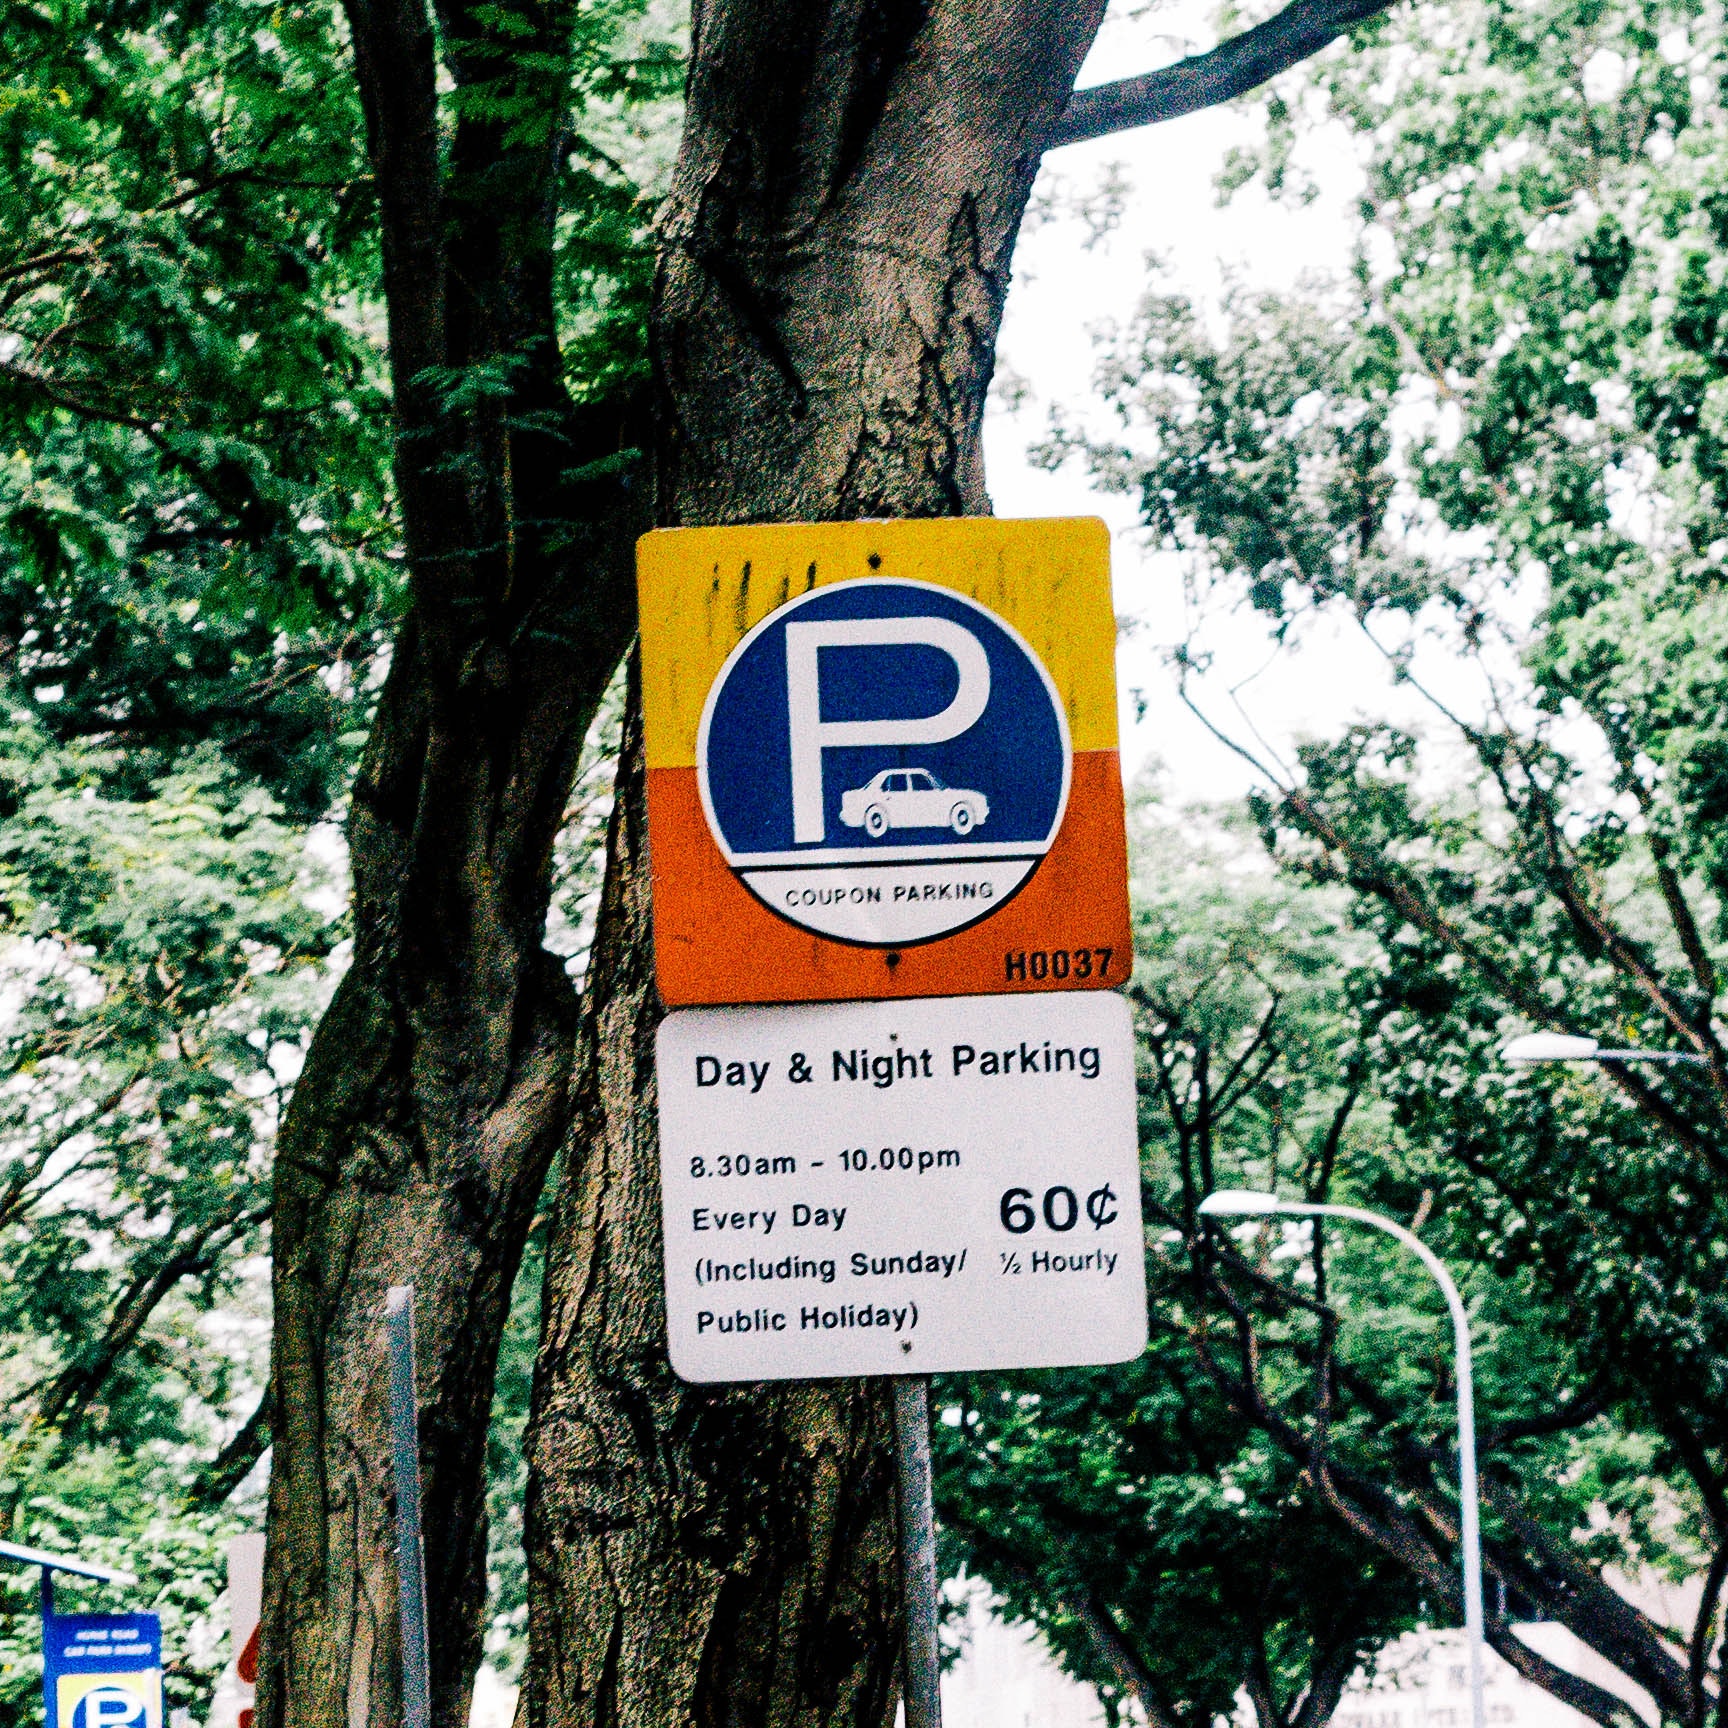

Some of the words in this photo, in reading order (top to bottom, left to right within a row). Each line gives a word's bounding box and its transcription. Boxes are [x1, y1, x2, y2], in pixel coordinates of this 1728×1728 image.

[784, 615, 992, 844] P
[784, 886, 883, 907] COUPON
[892, 879, 995, 903] PARKING
[1003, 946, 1115, 984] H0037
[695, 1055, 770, 1094] Day
[787, 1052, 814, 1084] &
[832, 1047, 933, 1087] Night
[952, 1041, 1102, 1081] Parking
[690, 1152, 797, 1179] 8.30am
[838, 1146, 961, 1174] 10.00pm
[692, 1207, 777, 1235] Every
[792, 1202, 848, 1232] Day
[998, 1182, 1119, 1236] 60¢
[695, 1253, 837, 1284] (Including
[850, 1249, 968, 1279] Sunday/
[1031, 1247, 1118, 1276] Hourly
[697, 1308, 786, 1335] Public
[800, 1300, 920, 1333] Holiday)
